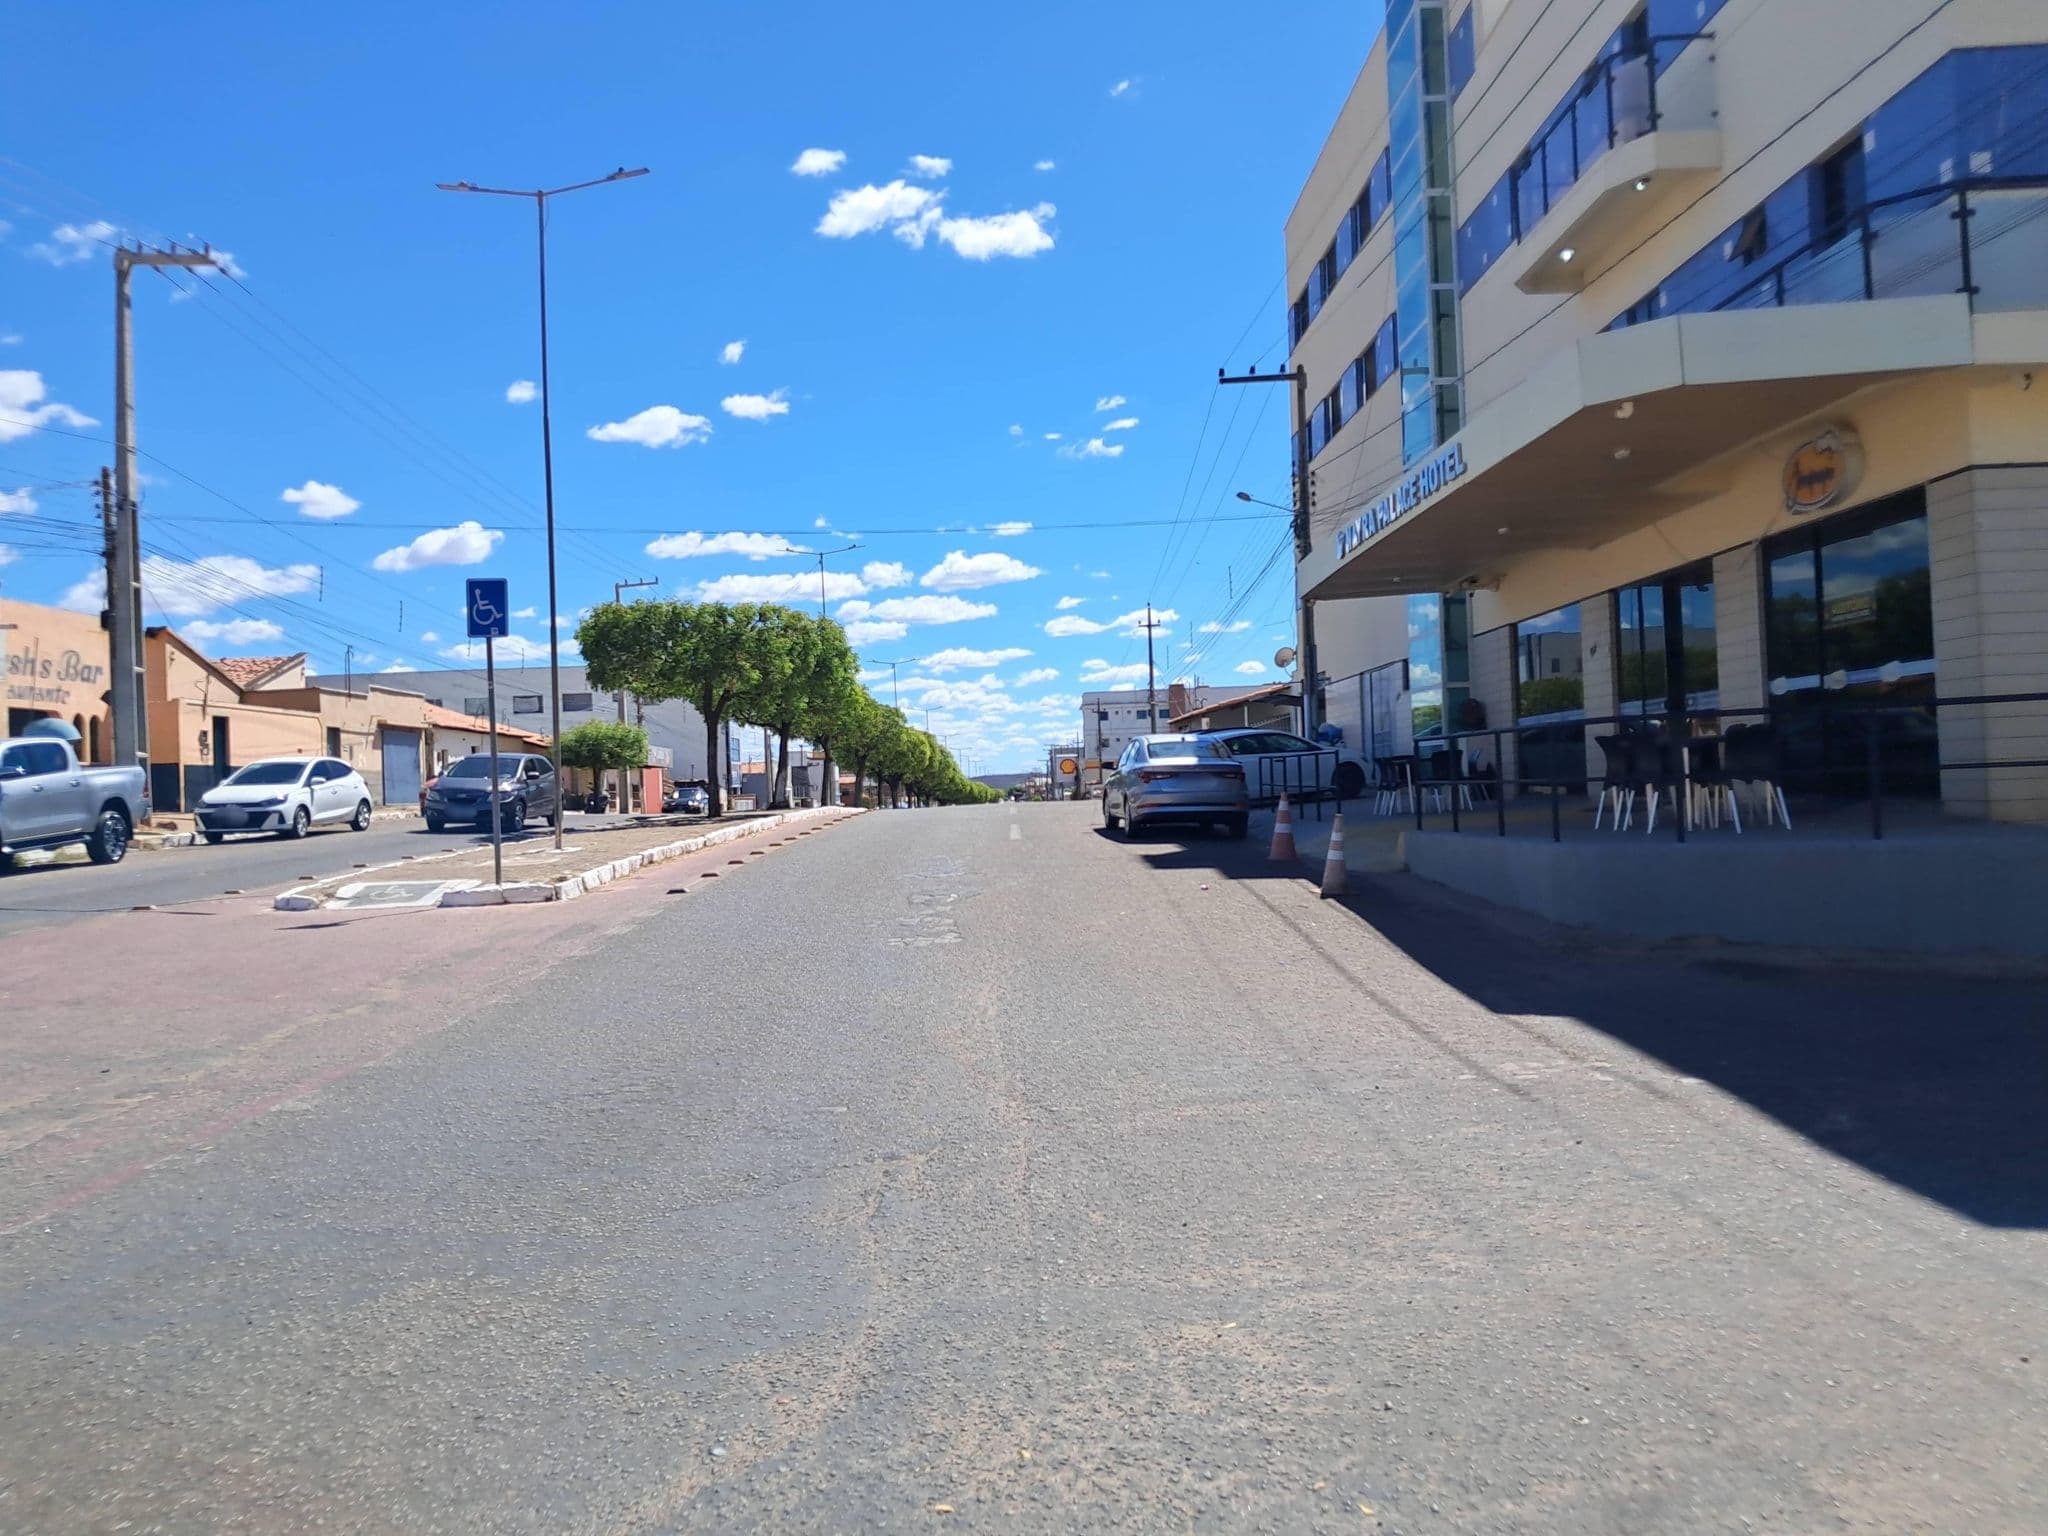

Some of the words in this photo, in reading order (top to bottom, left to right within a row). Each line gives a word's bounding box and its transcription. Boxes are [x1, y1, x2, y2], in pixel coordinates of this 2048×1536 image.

[1376, 475, 1420, 530] PALACE
[1419, 442, 1467, 499] HOTEL
[57, 649, 103, 684] Bar
